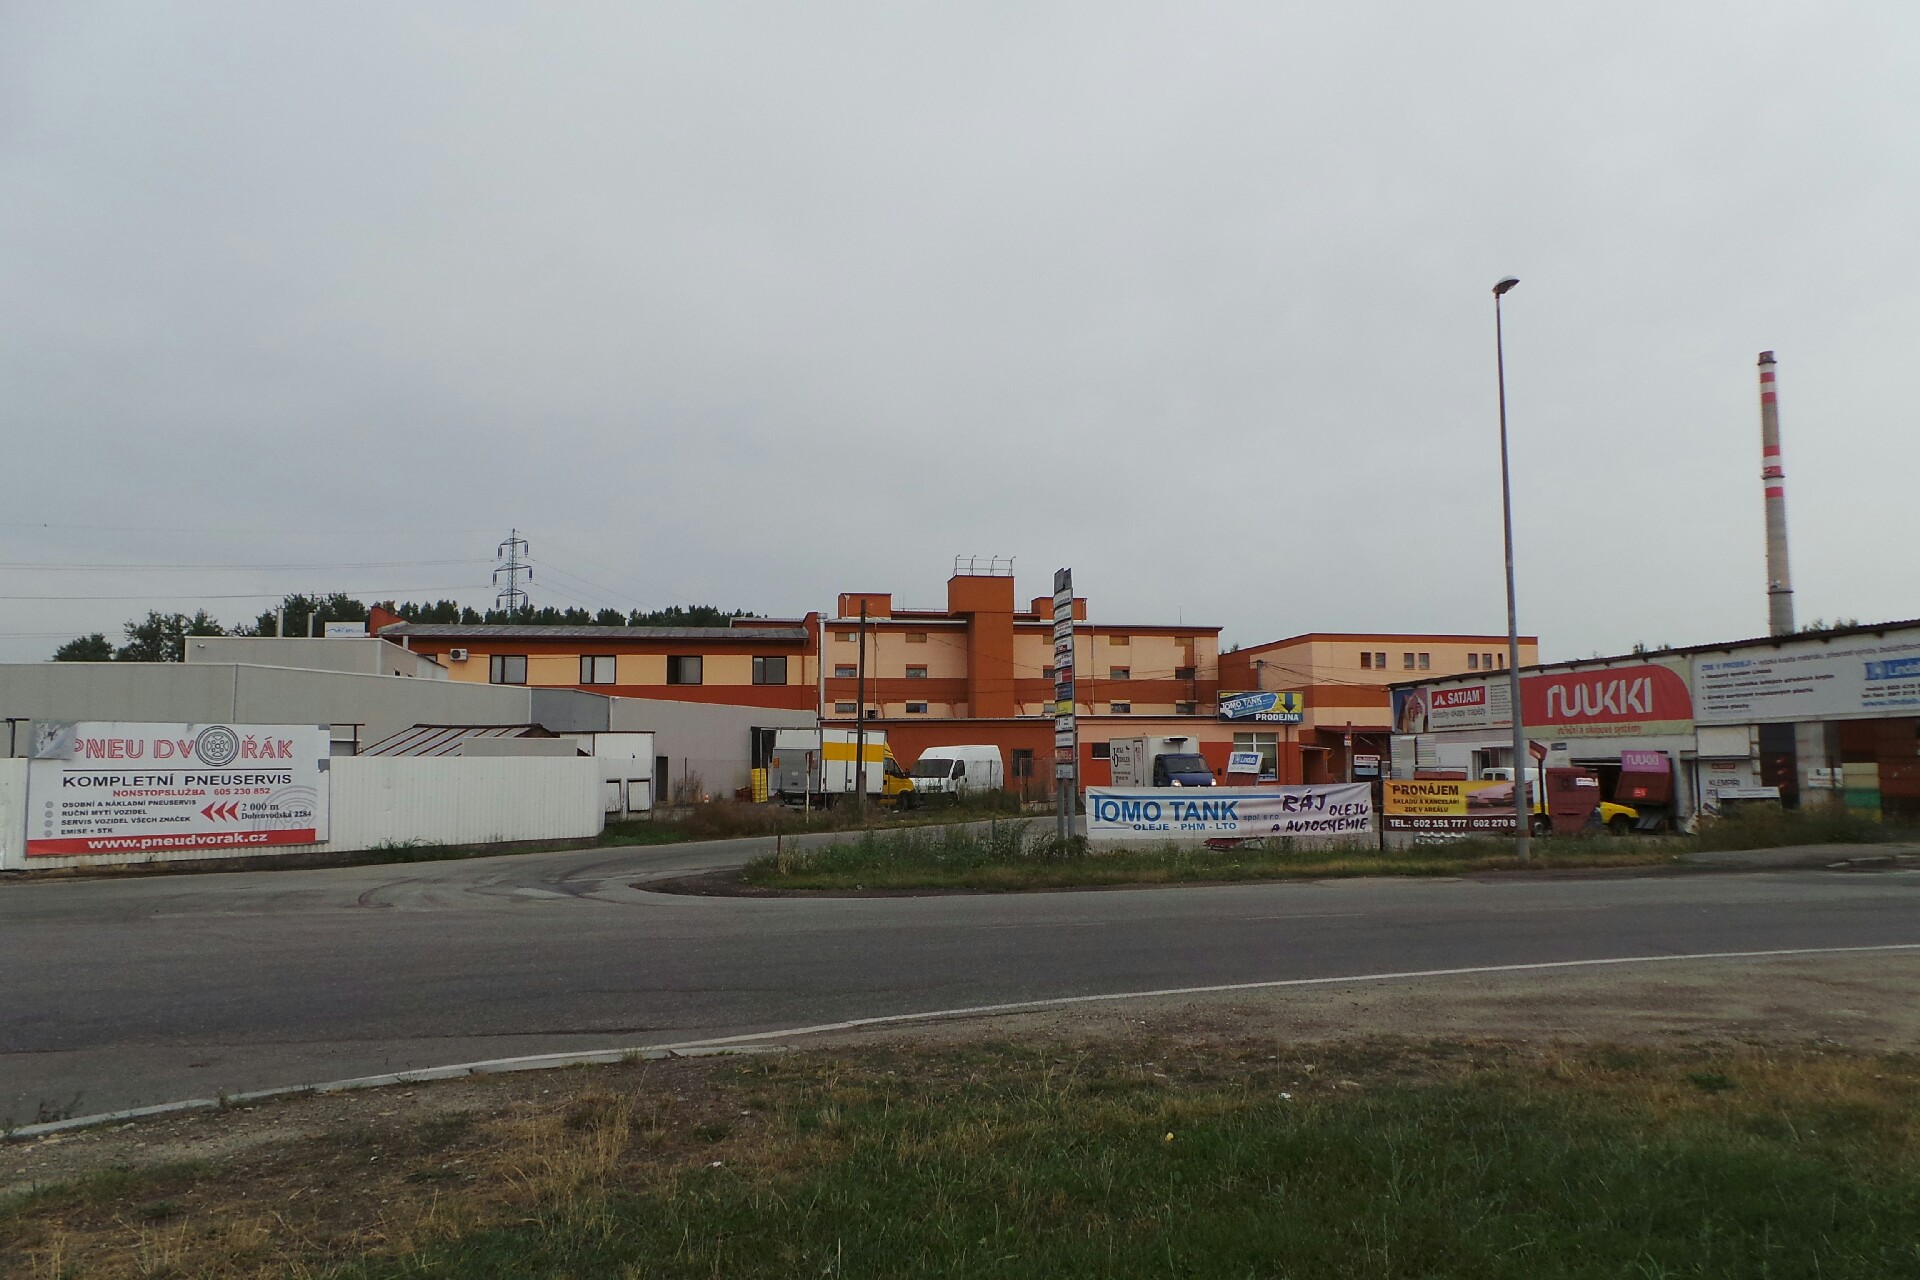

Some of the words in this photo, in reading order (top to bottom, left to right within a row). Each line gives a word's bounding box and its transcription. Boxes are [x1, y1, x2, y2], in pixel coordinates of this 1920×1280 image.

[1447, 689, 1480, 705] SATJAM
[1255, 713, 1299, 721] PRODEJNA
[63, 774, 174, 787] KOMPLETNÍ
[185, 774, 292, 786] PNEUSERVIS
[113, 788, 206, 797] NONSTOPSLUŽBA
[253, 787, 271, 795] 852
[1392, 783, 1459, 796] PRONÁJEM
[1282, 789, 1327, 812] RÁJ
[242, 803, 247, 811] 2
[249, 803, 267, 811] 000
[270, 803, 279, 811] m
[1089, 795, 1162, 822] TOMO
[1169, 800, 1239, 822] TANK
[62, 809, 89, 817] RUČNÍ
[131, 816, 158, 824] VŠECH
[159, 815, 191, 823] ZNAČEK
[1285, 817, 1369, 833] AUTOCHEMIE
[1389, 819, 1411, 828] TEL.:
[1413, 819, 1431, 828] 602
[1433, 819, 1450, 828] 151
[1451, 819, 1467, 828] 777
[1473, 819, 1490, 828] 602
[1491, 819, 1509, 827] 270
[1133, 823, 1169, 831] OLEJE
[1181, 823, 1206, 831] PHM
[88, 833, 268, 849] www.pneudvorak.cz
